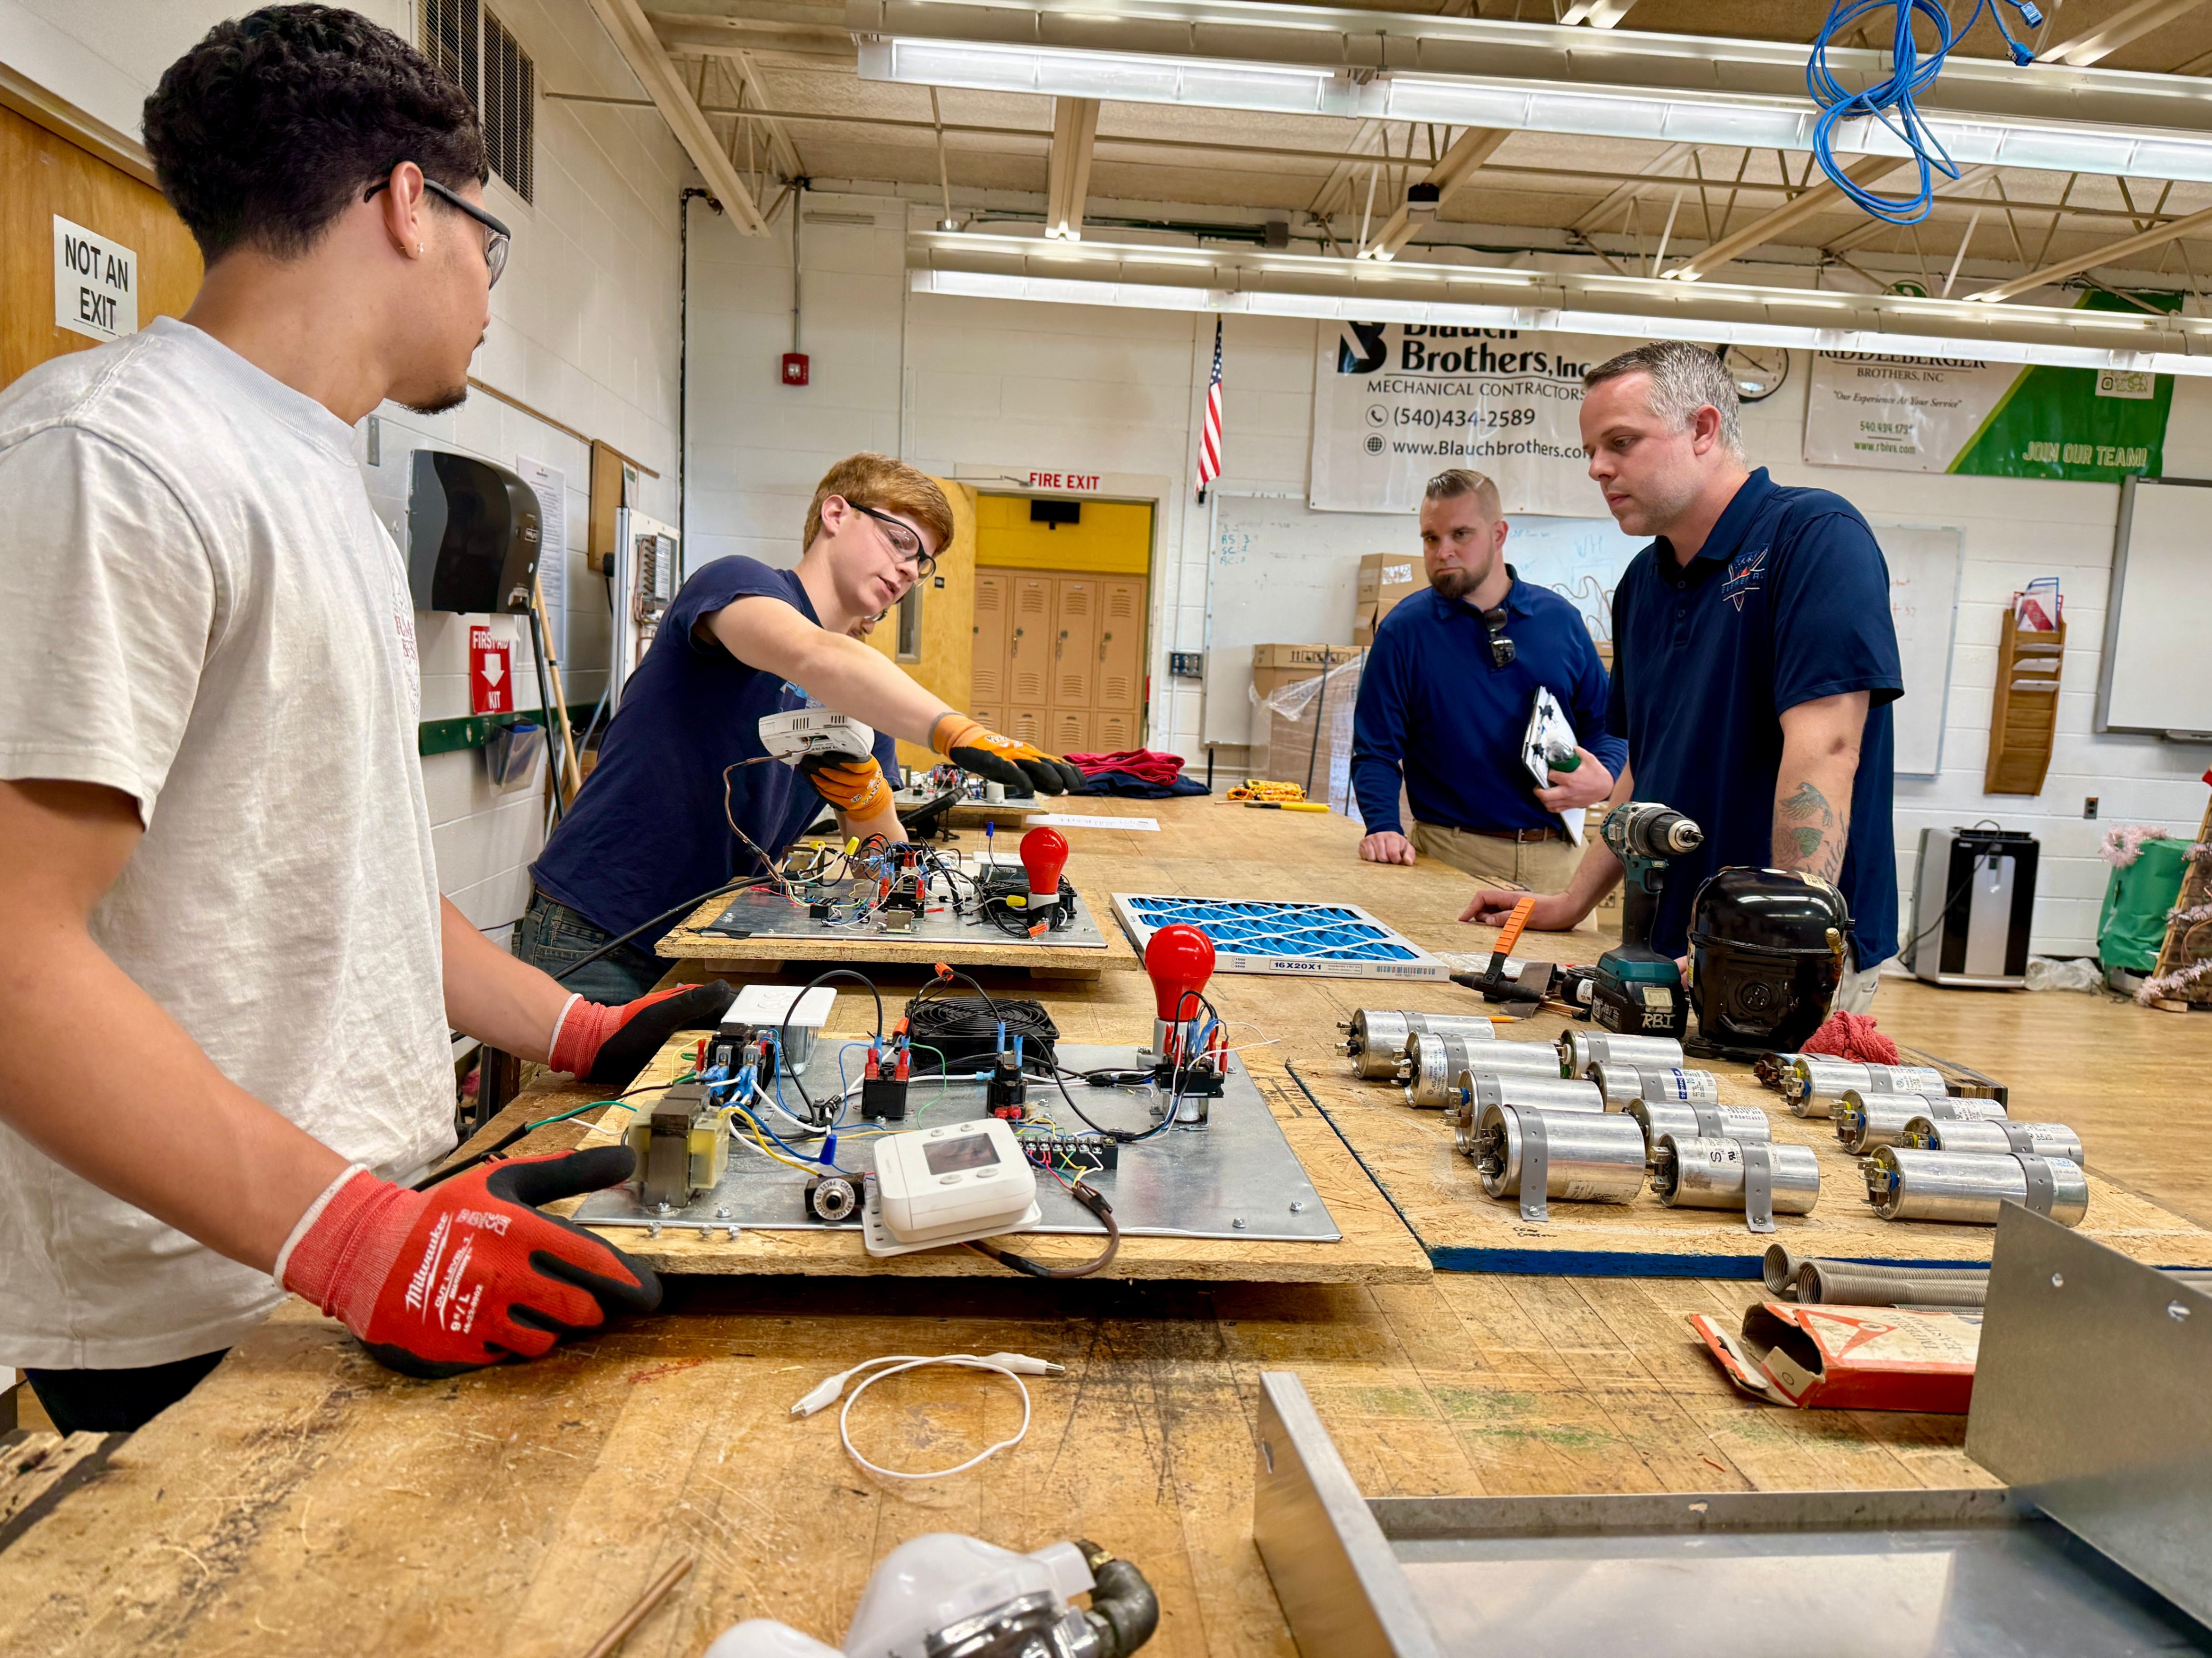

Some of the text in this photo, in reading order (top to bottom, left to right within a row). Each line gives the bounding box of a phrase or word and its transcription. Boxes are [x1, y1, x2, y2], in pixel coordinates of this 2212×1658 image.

[65, 234, 128, 292] NOT AN
[80, 286, 117, 330] EXIT
[1401, 340, 1552, 377] Brothers,
[1857, 367, 1945, 382] BROTHERS, INC
[1367, 380, 1473, 396] MECHANICAL
[1394, 407, 1536, 428] (540)434-2589
[2022, 441, 2148, 467] JOIN OUR TEAM!
[1030, 472, 1100, 490] FIRE EXIT
[489, 690, 501, 709] KIT
[1641, 1013, 1676, 1029] RBI
[819, 1180, 837, 1192] PRESS
[405, 1211, 448, 1313] Milwaukee
[434, 1283, 447, 1308] CUT
[443, 1245, 467, 1282] LEVEL
[458, 1293, 471, 1304] L
